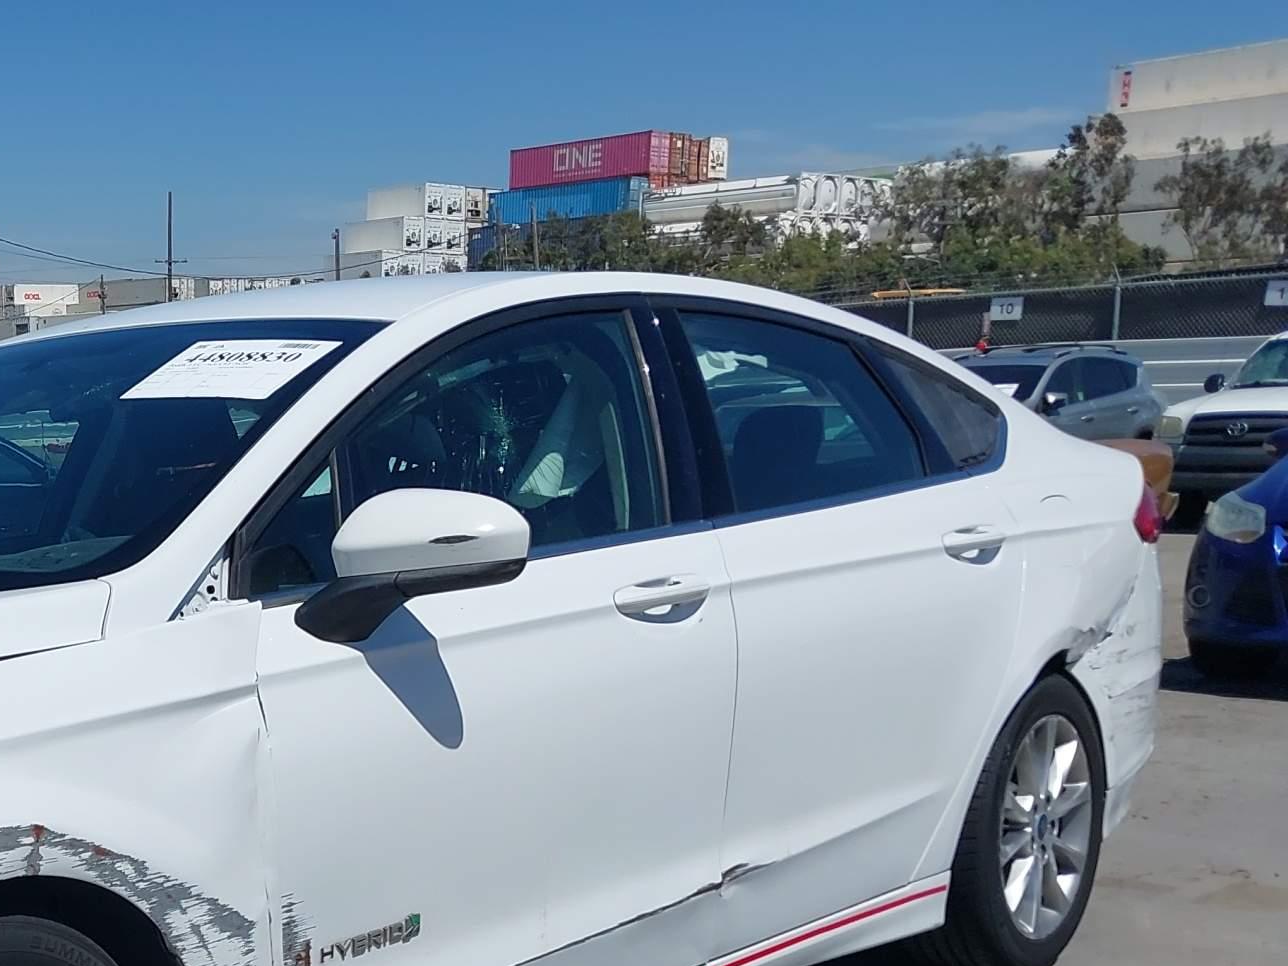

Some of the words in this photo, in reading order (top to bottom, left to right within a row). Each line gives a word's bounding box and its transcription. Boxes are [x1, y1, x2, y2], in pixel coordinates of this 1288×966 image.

[553, 143, 601, 172] ONE
[999, 303, 1014, 315] 10
[185, 351, 303, 363] 44808830
[320, 919, 408, 964] HYBRID
